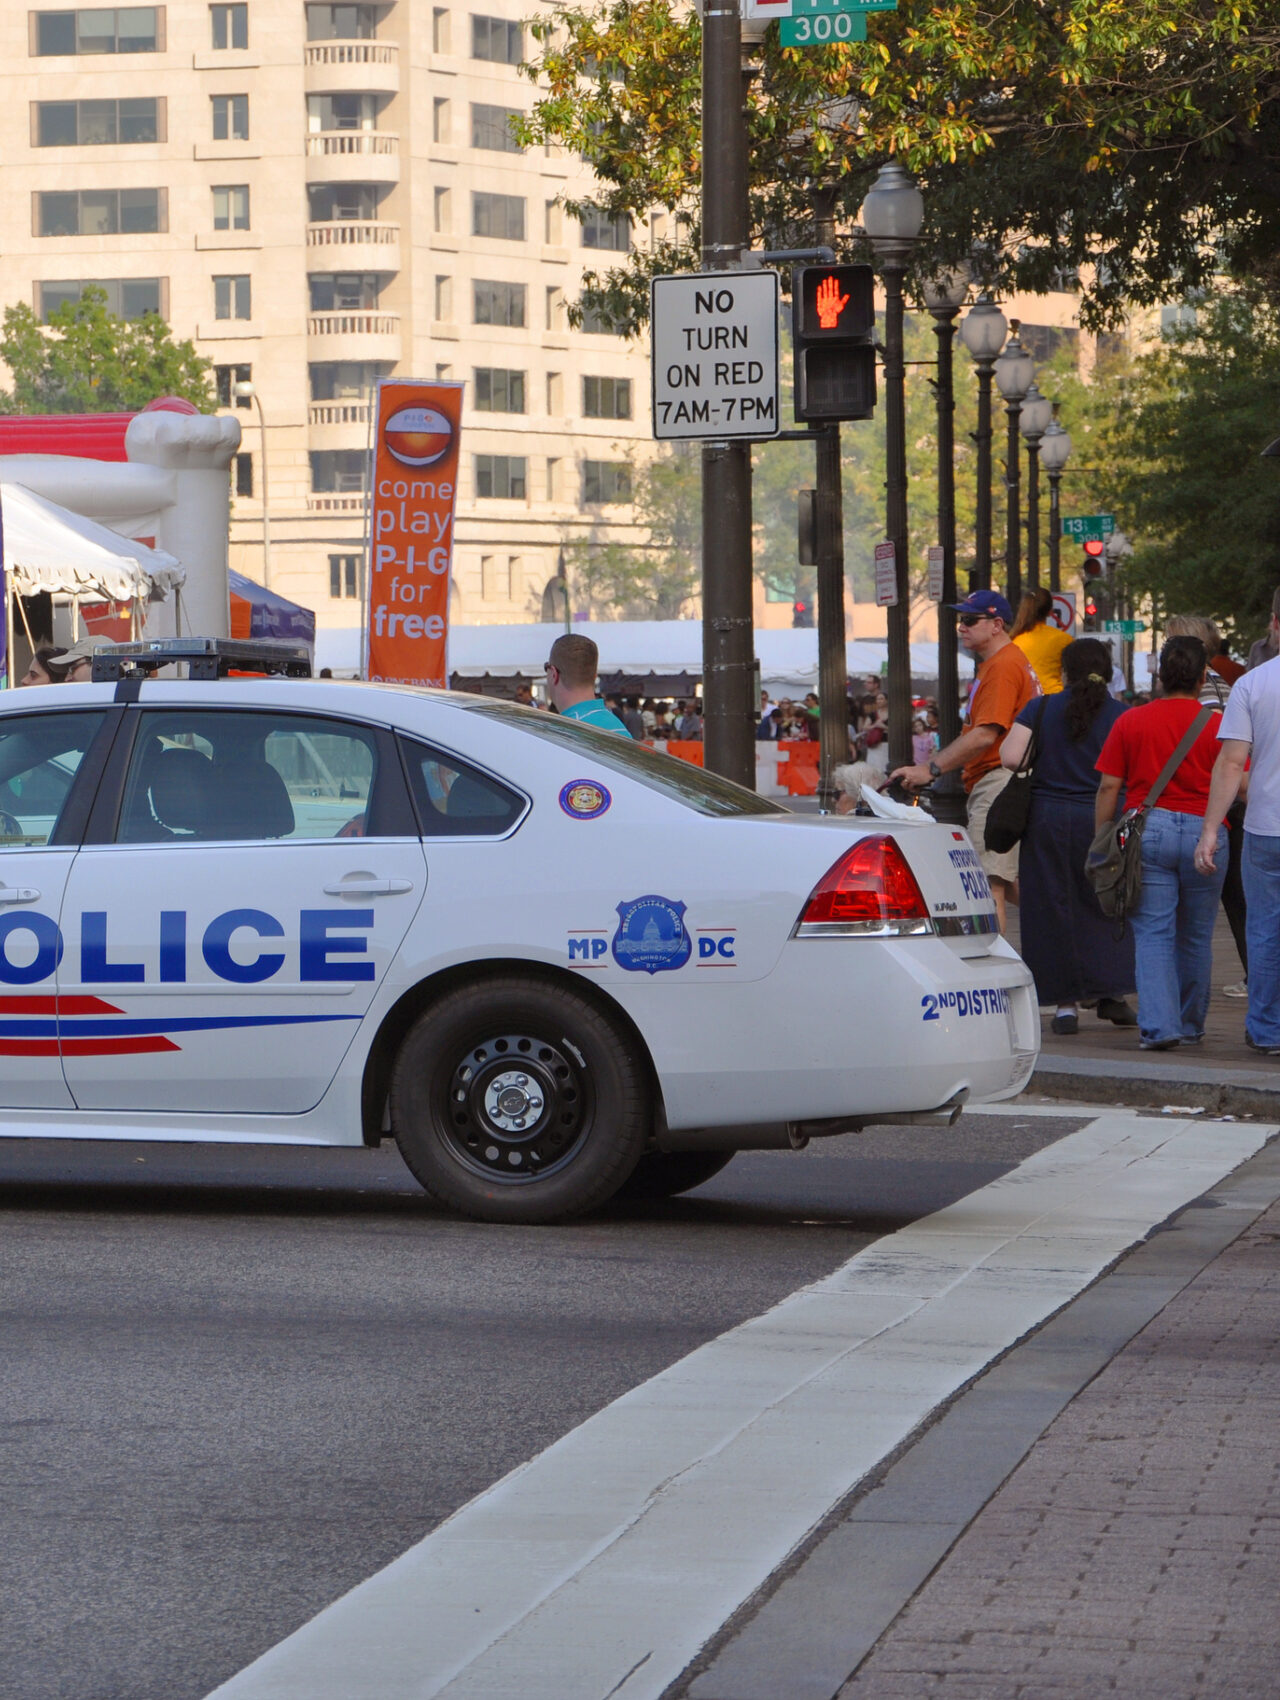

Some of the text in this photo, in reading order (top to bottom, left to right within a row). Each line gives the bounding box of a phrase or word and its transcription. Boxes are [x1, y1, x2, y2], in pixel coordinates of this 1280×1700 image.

[794, 13, 852, 41] 300
[695, 290, 734, 314] NO
[682, 325, 748, 351] TURN
[667, 361, 764, 388] ON RED
[657, 396, 774, 424] 7AM-7PM
[379, 480, 453, 500] come
[375, 502, 452, 543] play
[375, 545, 448, 575] P-I-G
[390, 576, 432, 602] for
[374, 605, 445, 639] free
[666, 907, 681, 932] POLICE
[568, 937, 735, 959] MP DC
